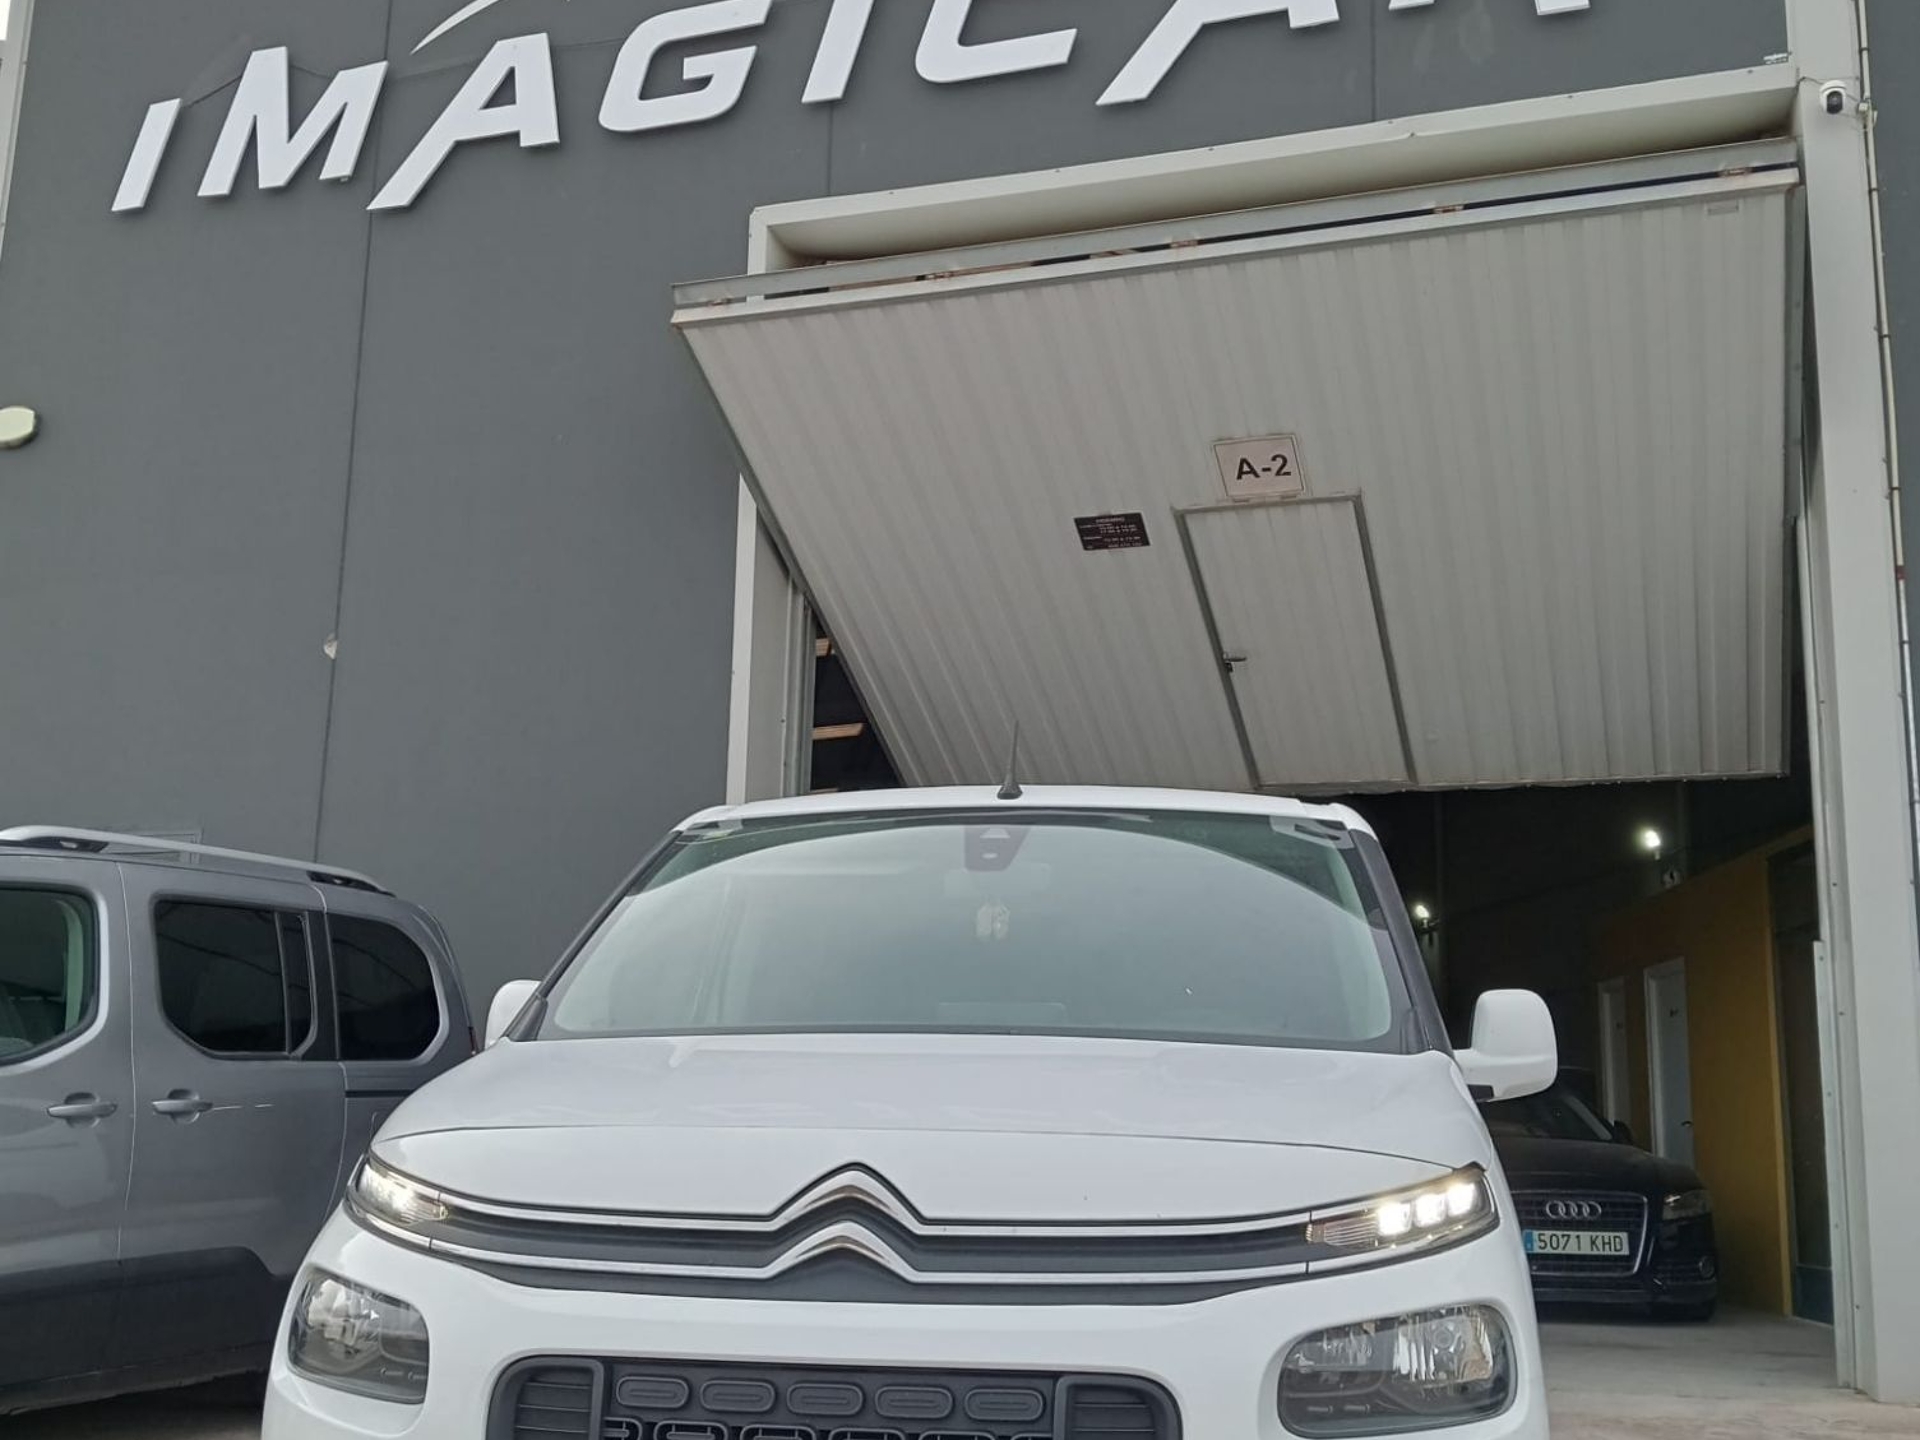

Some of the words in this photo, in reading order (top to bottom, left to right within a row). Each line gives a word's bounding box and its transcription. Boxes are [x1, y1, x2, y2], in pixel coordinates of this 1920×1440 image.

[112, 0, 1589, 211] IMAGICA
[1236, 454, 1292, 480] A-2
[1537, 1233, 1582, 1251] 5071
[1590, 1235, 1624, 1252] KHD
